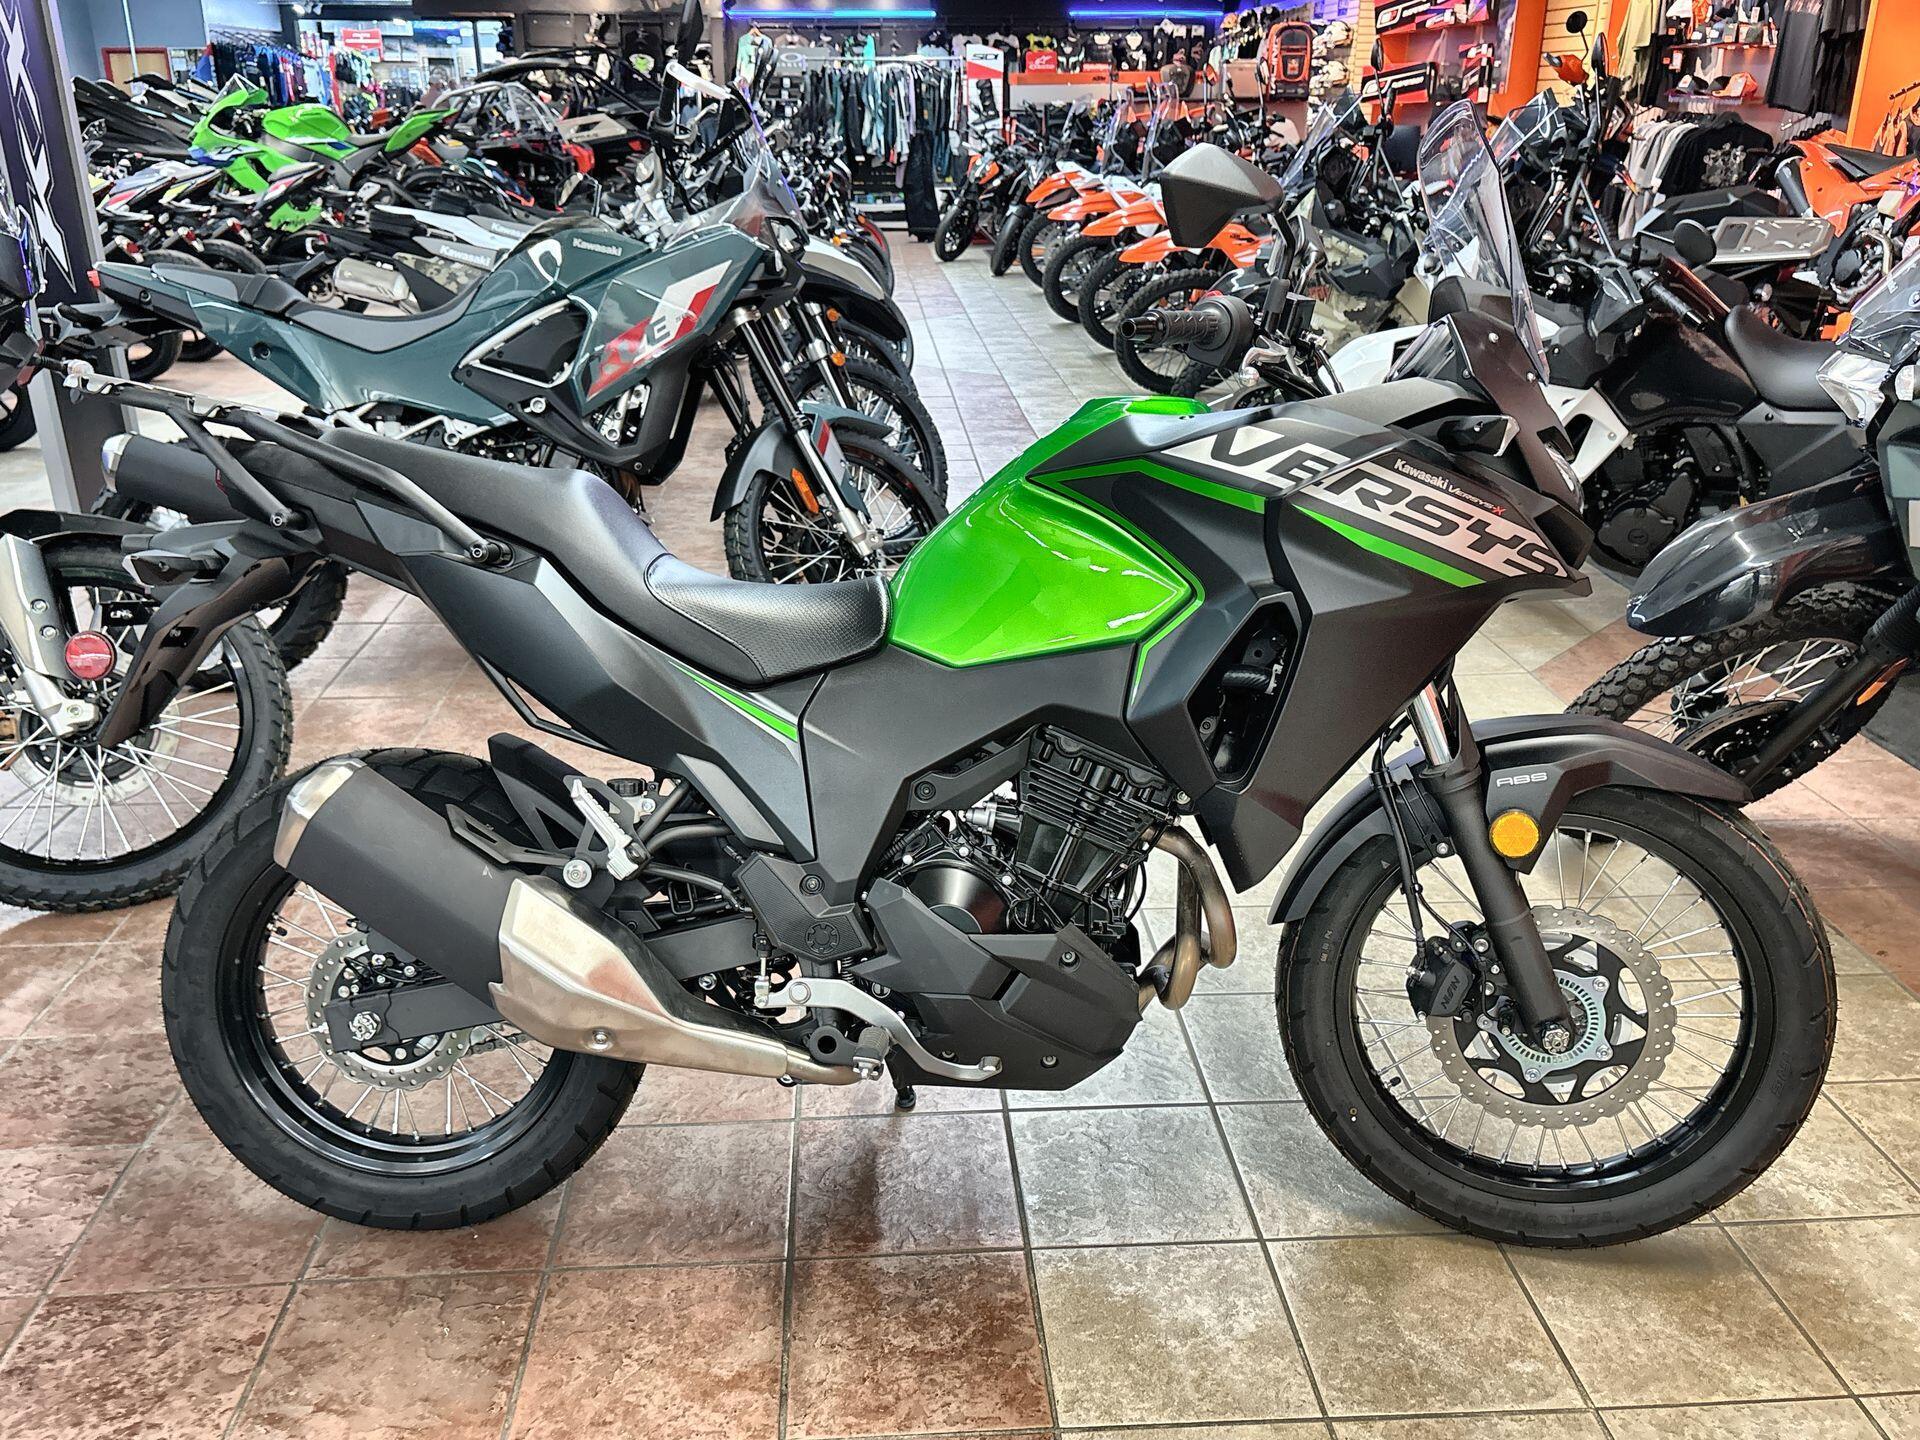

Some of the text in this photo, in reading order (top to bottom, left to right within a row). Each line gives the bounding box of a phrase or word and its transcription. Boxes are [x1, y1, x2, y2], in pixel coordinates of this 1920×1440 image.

[440, 245, 491, 265] Kawasaki
[573, 237, 623, 257] Kawasaki
[1394, 459, 1449, 491] Kawasaki
[1211, 426, 1561, 577] VERSYS
[1497, 772, 1547, 787] ABS
